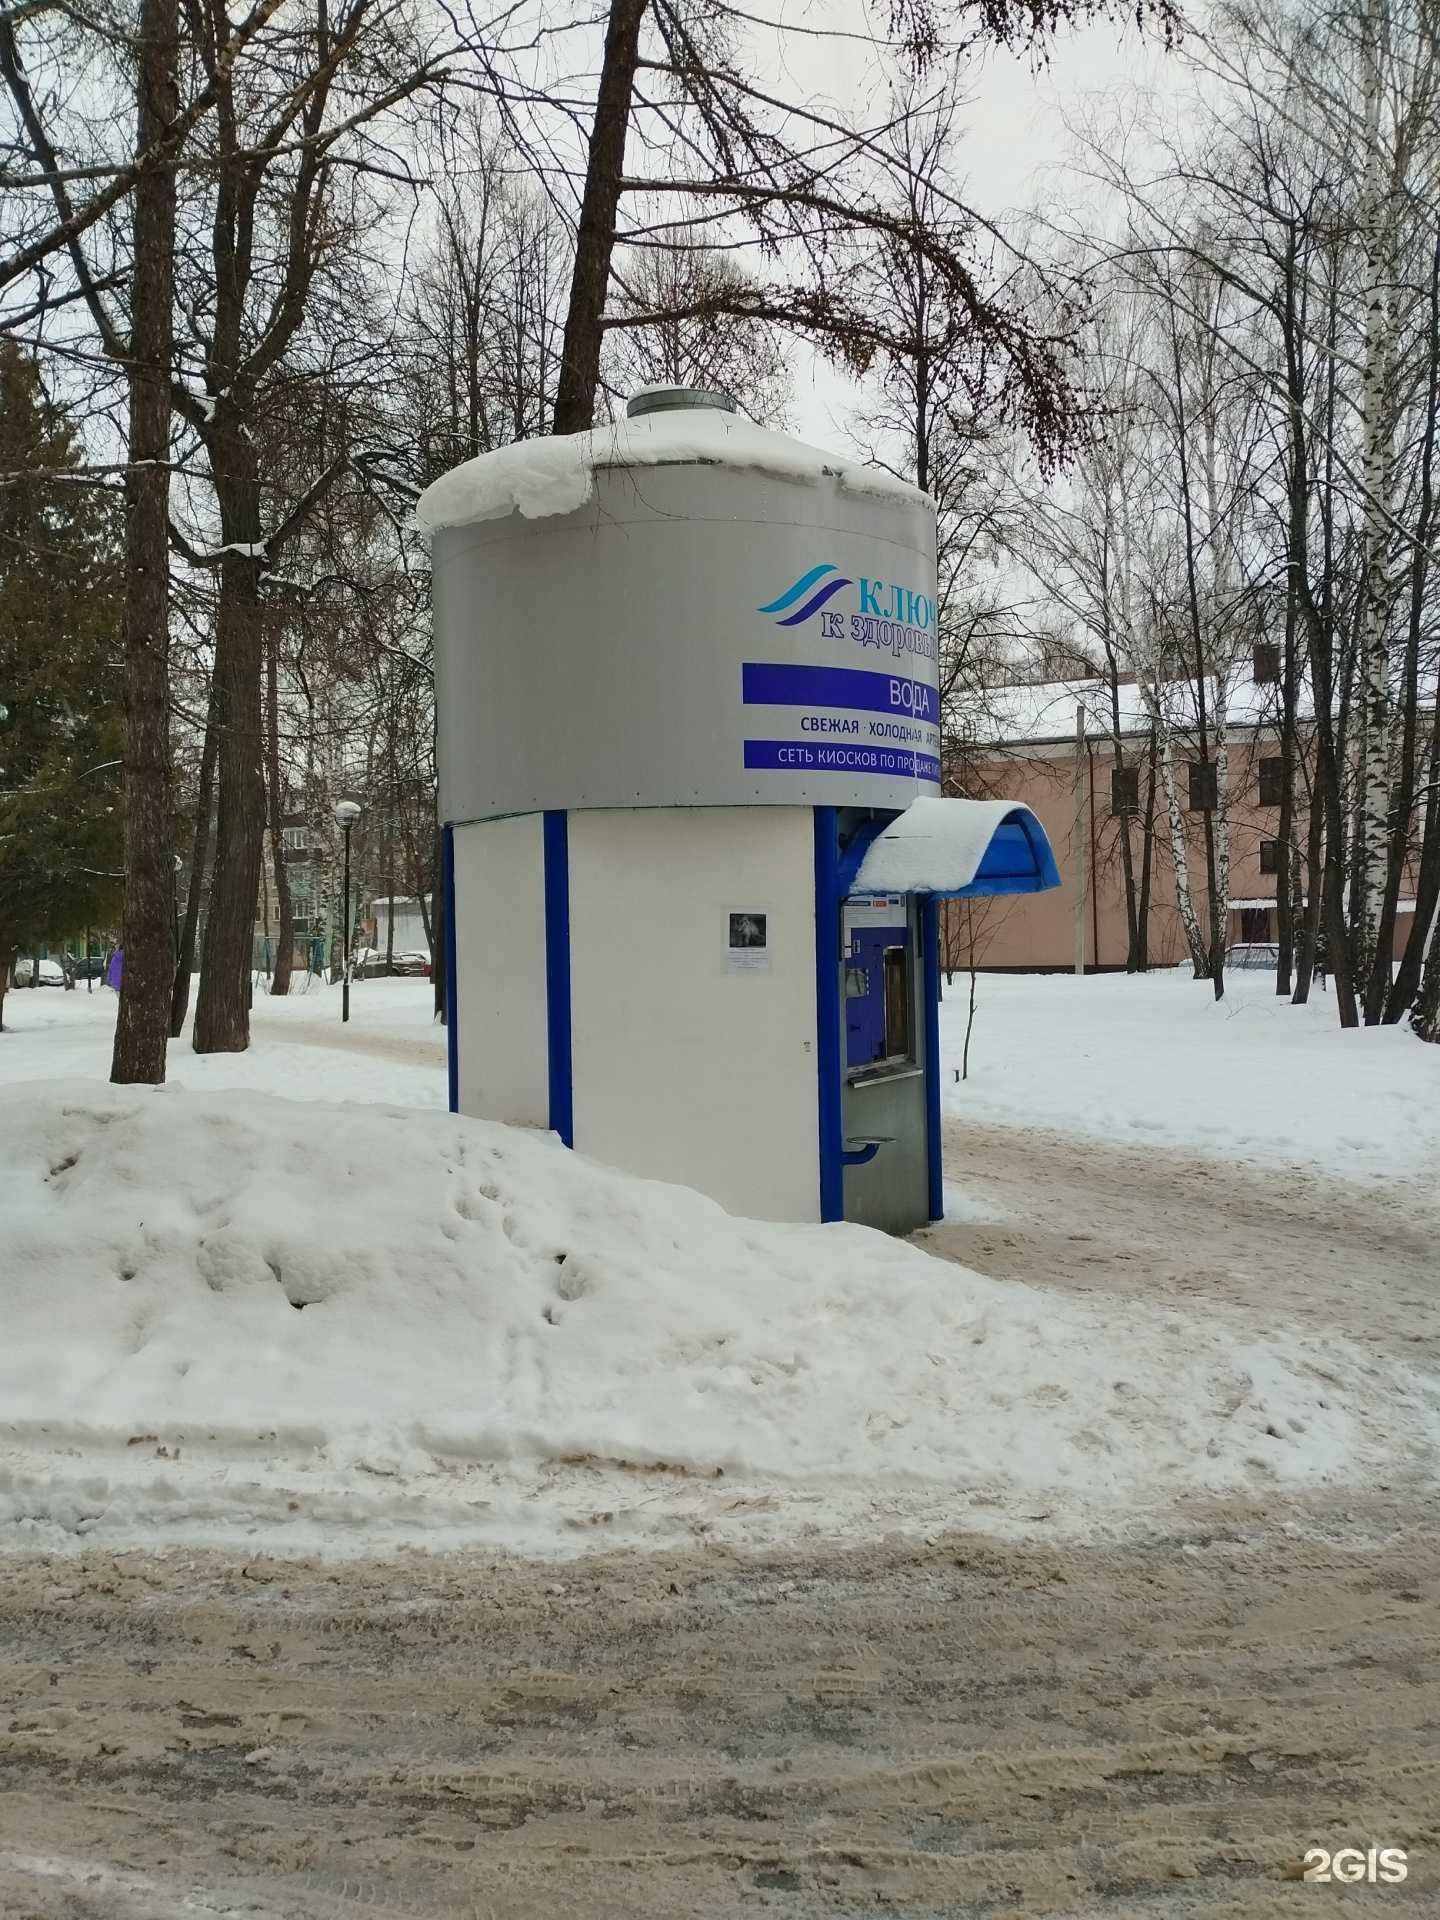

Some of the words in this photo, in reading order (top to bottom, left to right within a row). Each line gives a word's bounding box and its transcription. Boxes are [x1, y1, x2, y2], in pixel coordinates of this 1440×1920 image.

[889, 679, 930, 716] ВОДА
[800, 716, 859, 734] СВЕЖАЯ
[869, 721, 922, 743] ХОЛОДНАЯ
[778, 748, 814, 763] СЕТЬ
[818, 749, 877, 766] КИОСКОВ
[880, 754, 895, 768] ПО
